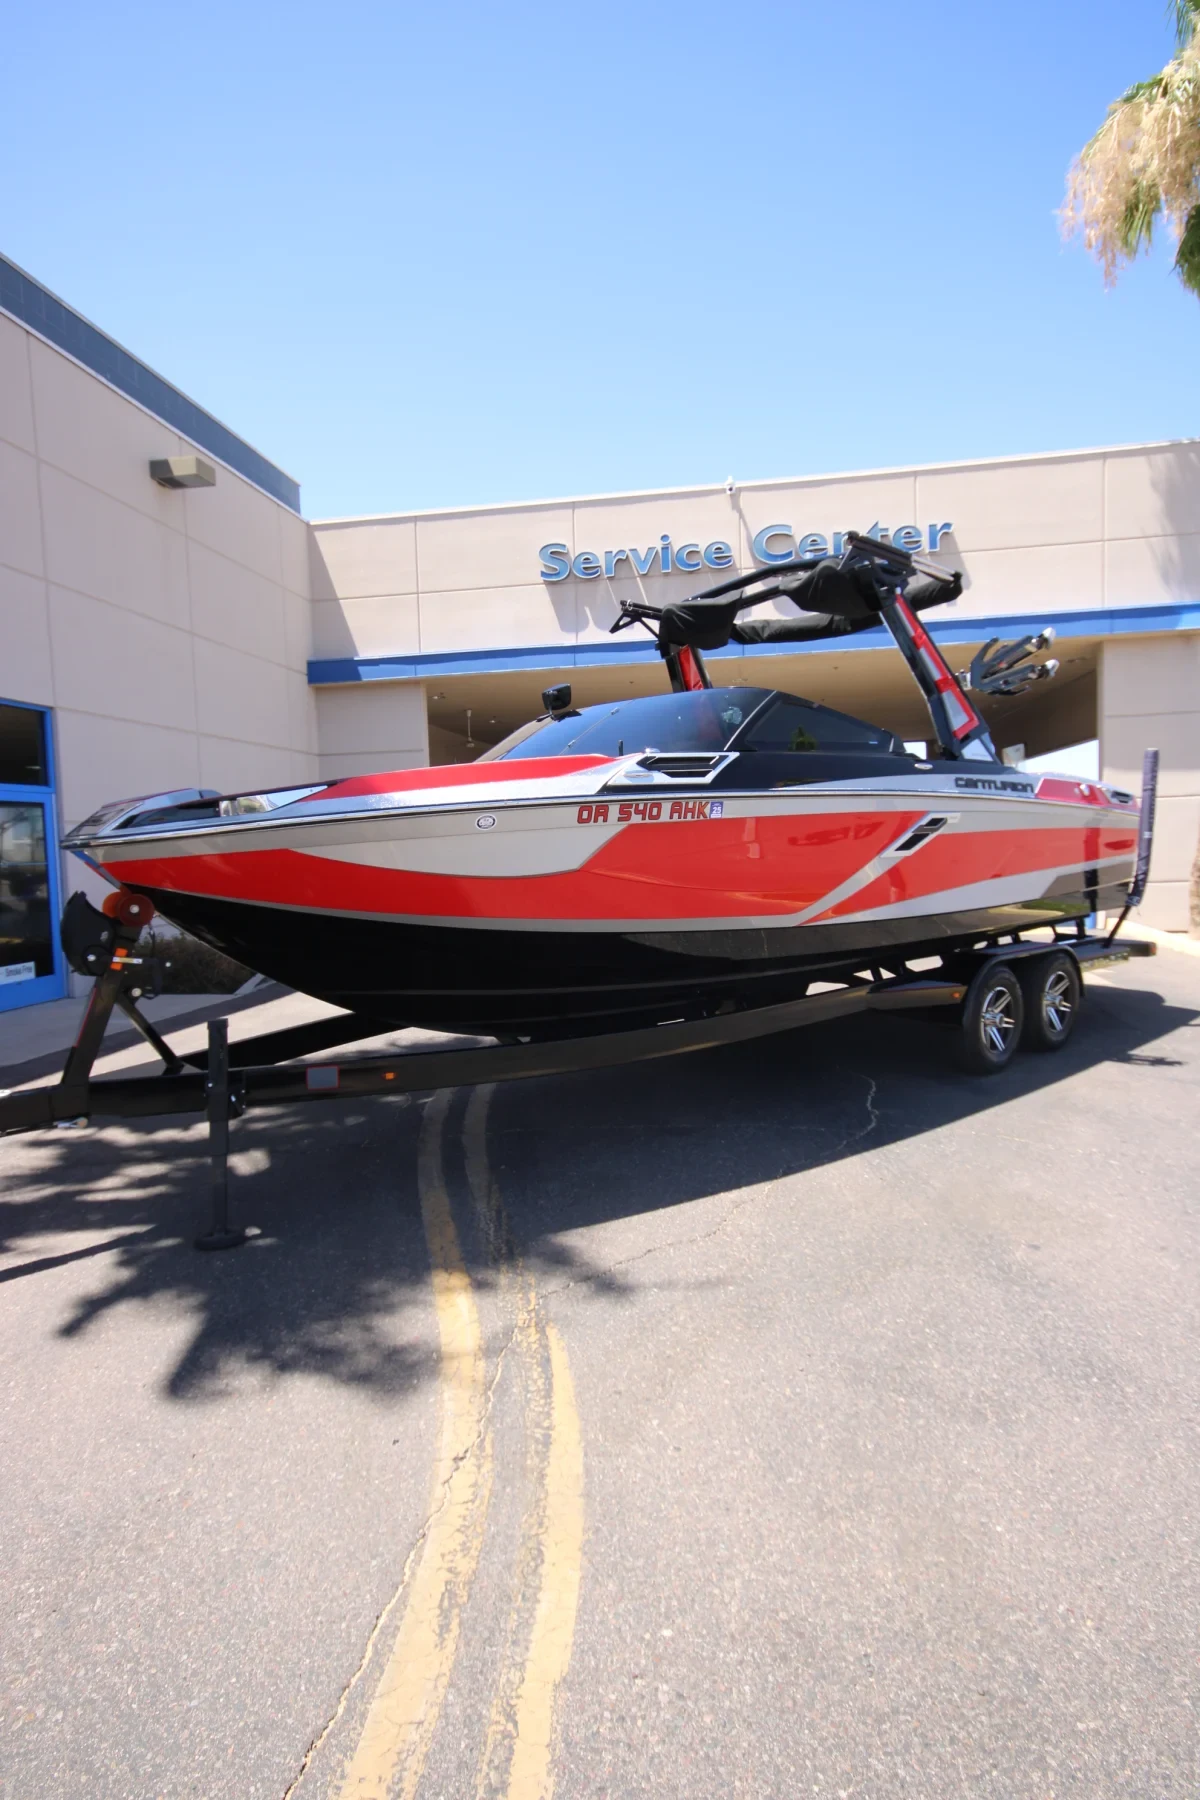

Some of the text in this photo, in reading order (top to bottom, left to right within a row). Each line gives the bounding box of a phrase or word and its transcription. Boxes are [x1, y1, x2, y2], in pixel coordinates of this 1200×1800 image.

[538, 533, 734, 581] Service
[577, 801, 709, 824] OR 540 AHK
[712, 806, 722, 814] 25
